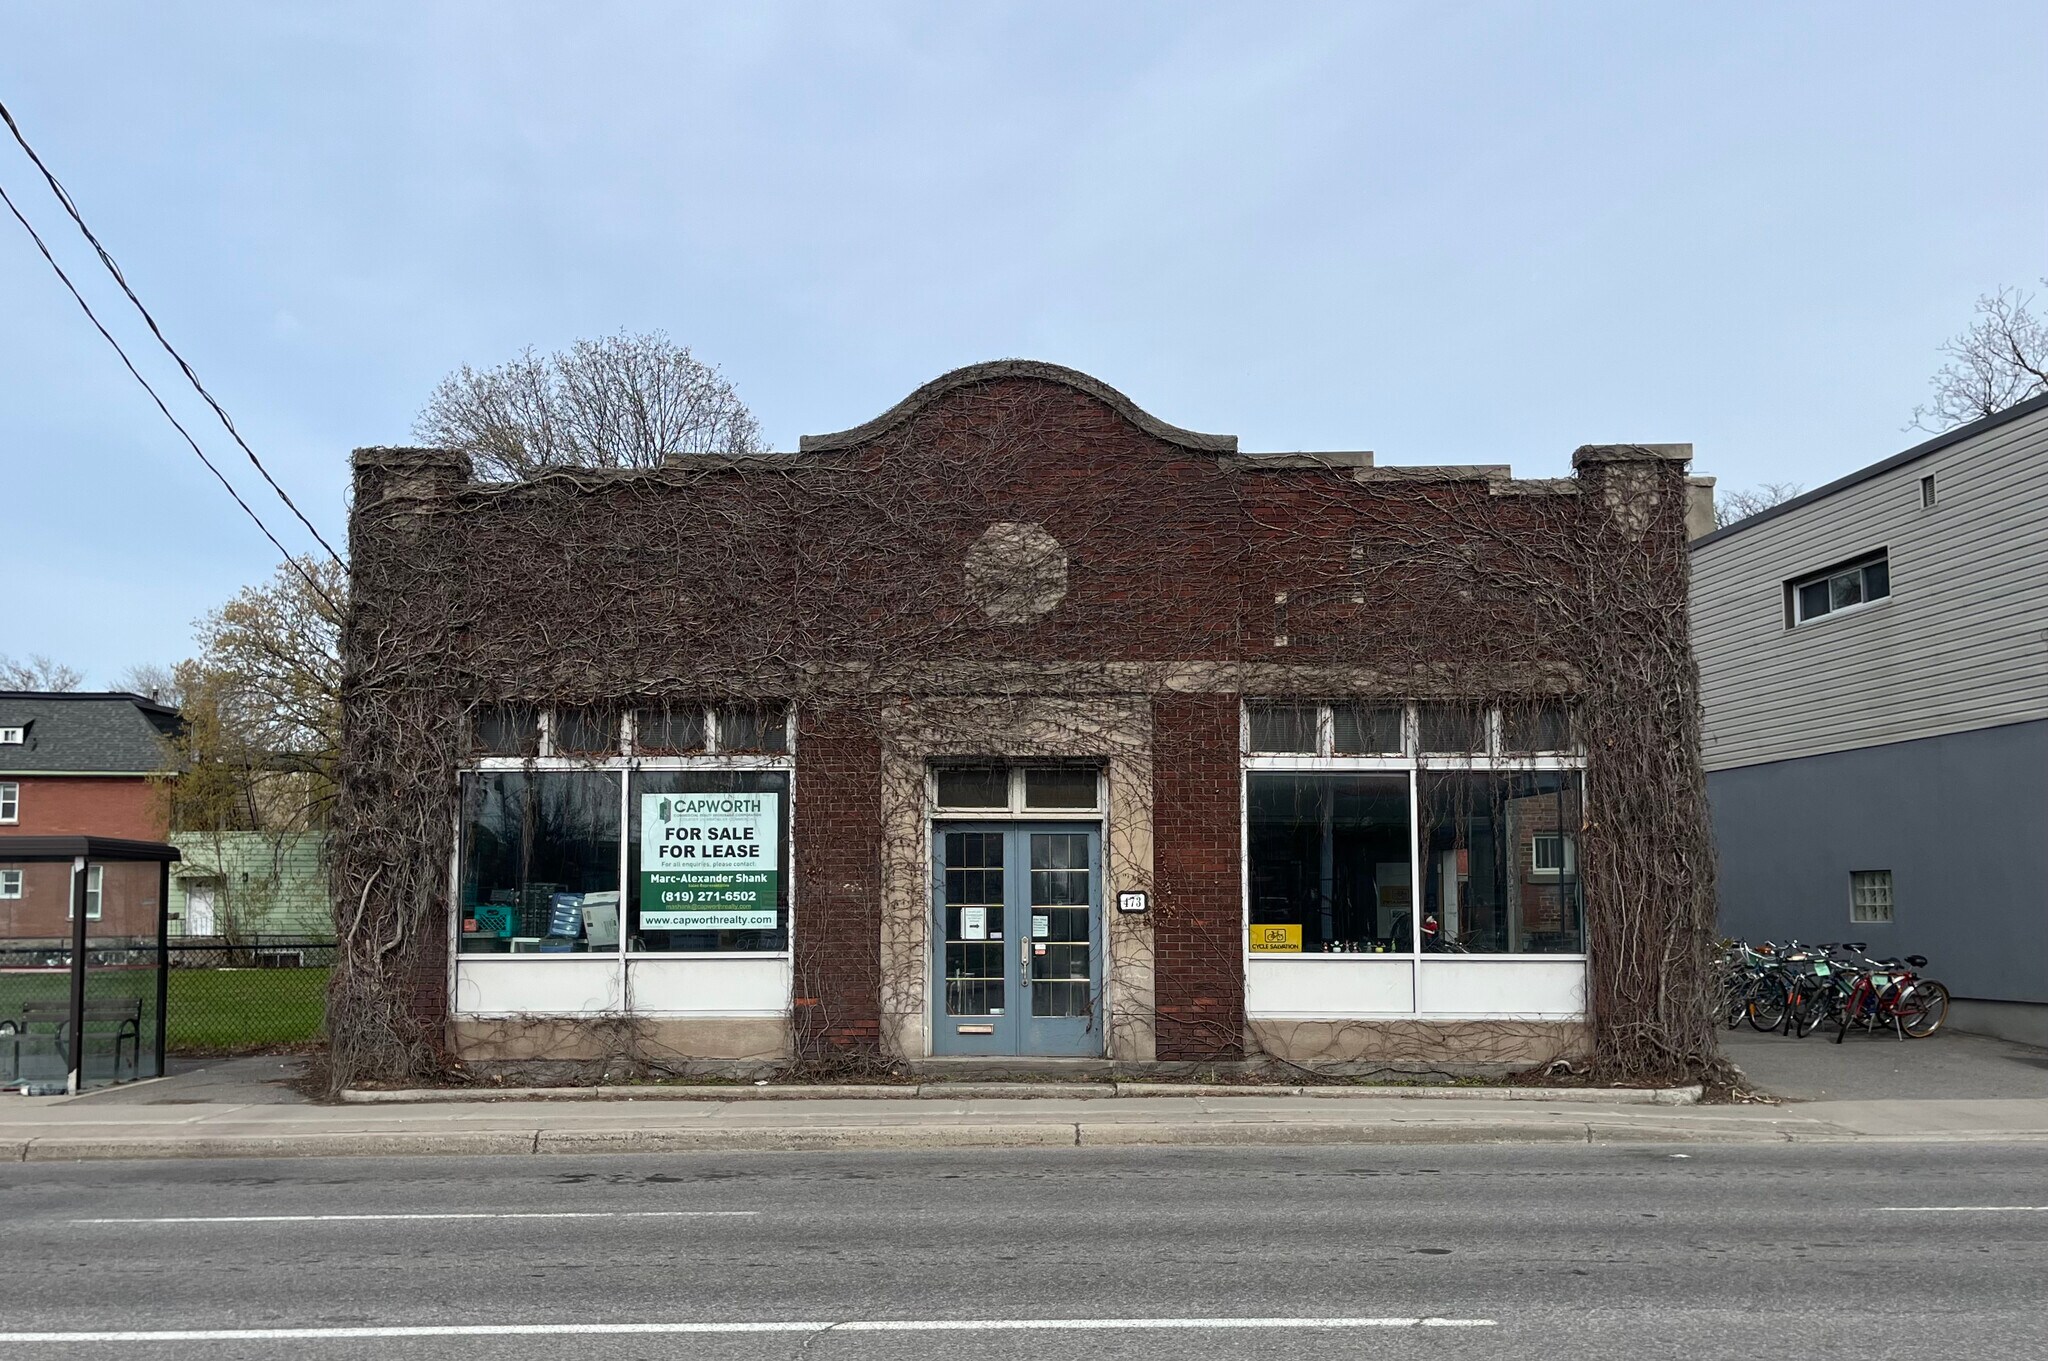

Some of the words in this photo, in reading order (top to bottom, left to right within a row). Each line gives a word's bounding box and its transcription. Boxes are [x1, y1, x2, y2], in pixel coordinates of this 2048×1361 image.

[674, 800, 761, 813] CAPWORTH
[665, 828, 702, 841] FOR
[708, 828, 754, 841] SALE
[659, 845, 696, 858] FOR
[702, 845, 760, 858] LEASE
[651, 874, 734, 883] Marc-Alexander
[735, 873, 768, 883] Shank
[661, 891, 694, 903] (819)
[698, 891, 757, 902] 271-6502
[645, 915, 772, 926] www.capworthrealty.com
